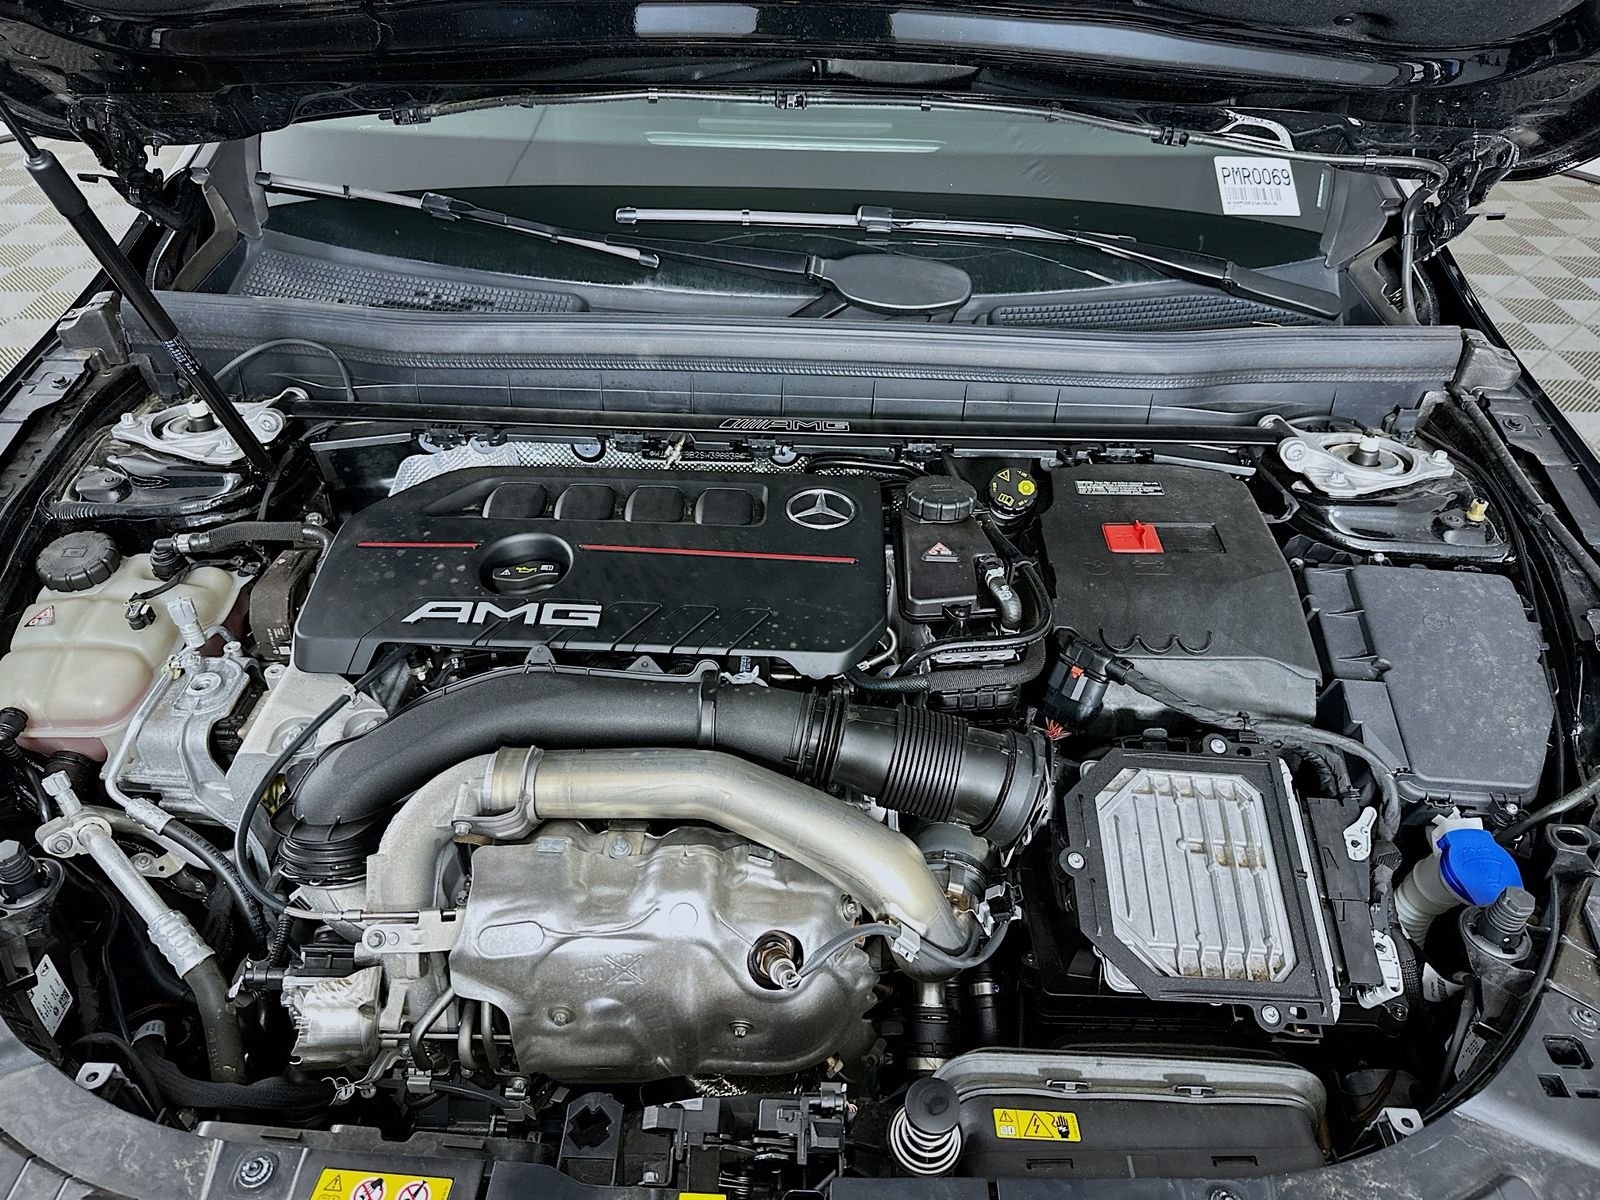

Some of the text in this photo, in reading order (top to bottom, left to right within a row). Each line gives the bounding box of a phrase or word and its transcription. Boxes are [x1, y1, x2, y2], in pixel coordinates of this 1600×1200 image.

[1221, 167, 1291, 186] PMR0069
[761, 419, 850, 431] AMG
[401, 601, 603, 628] AMG
